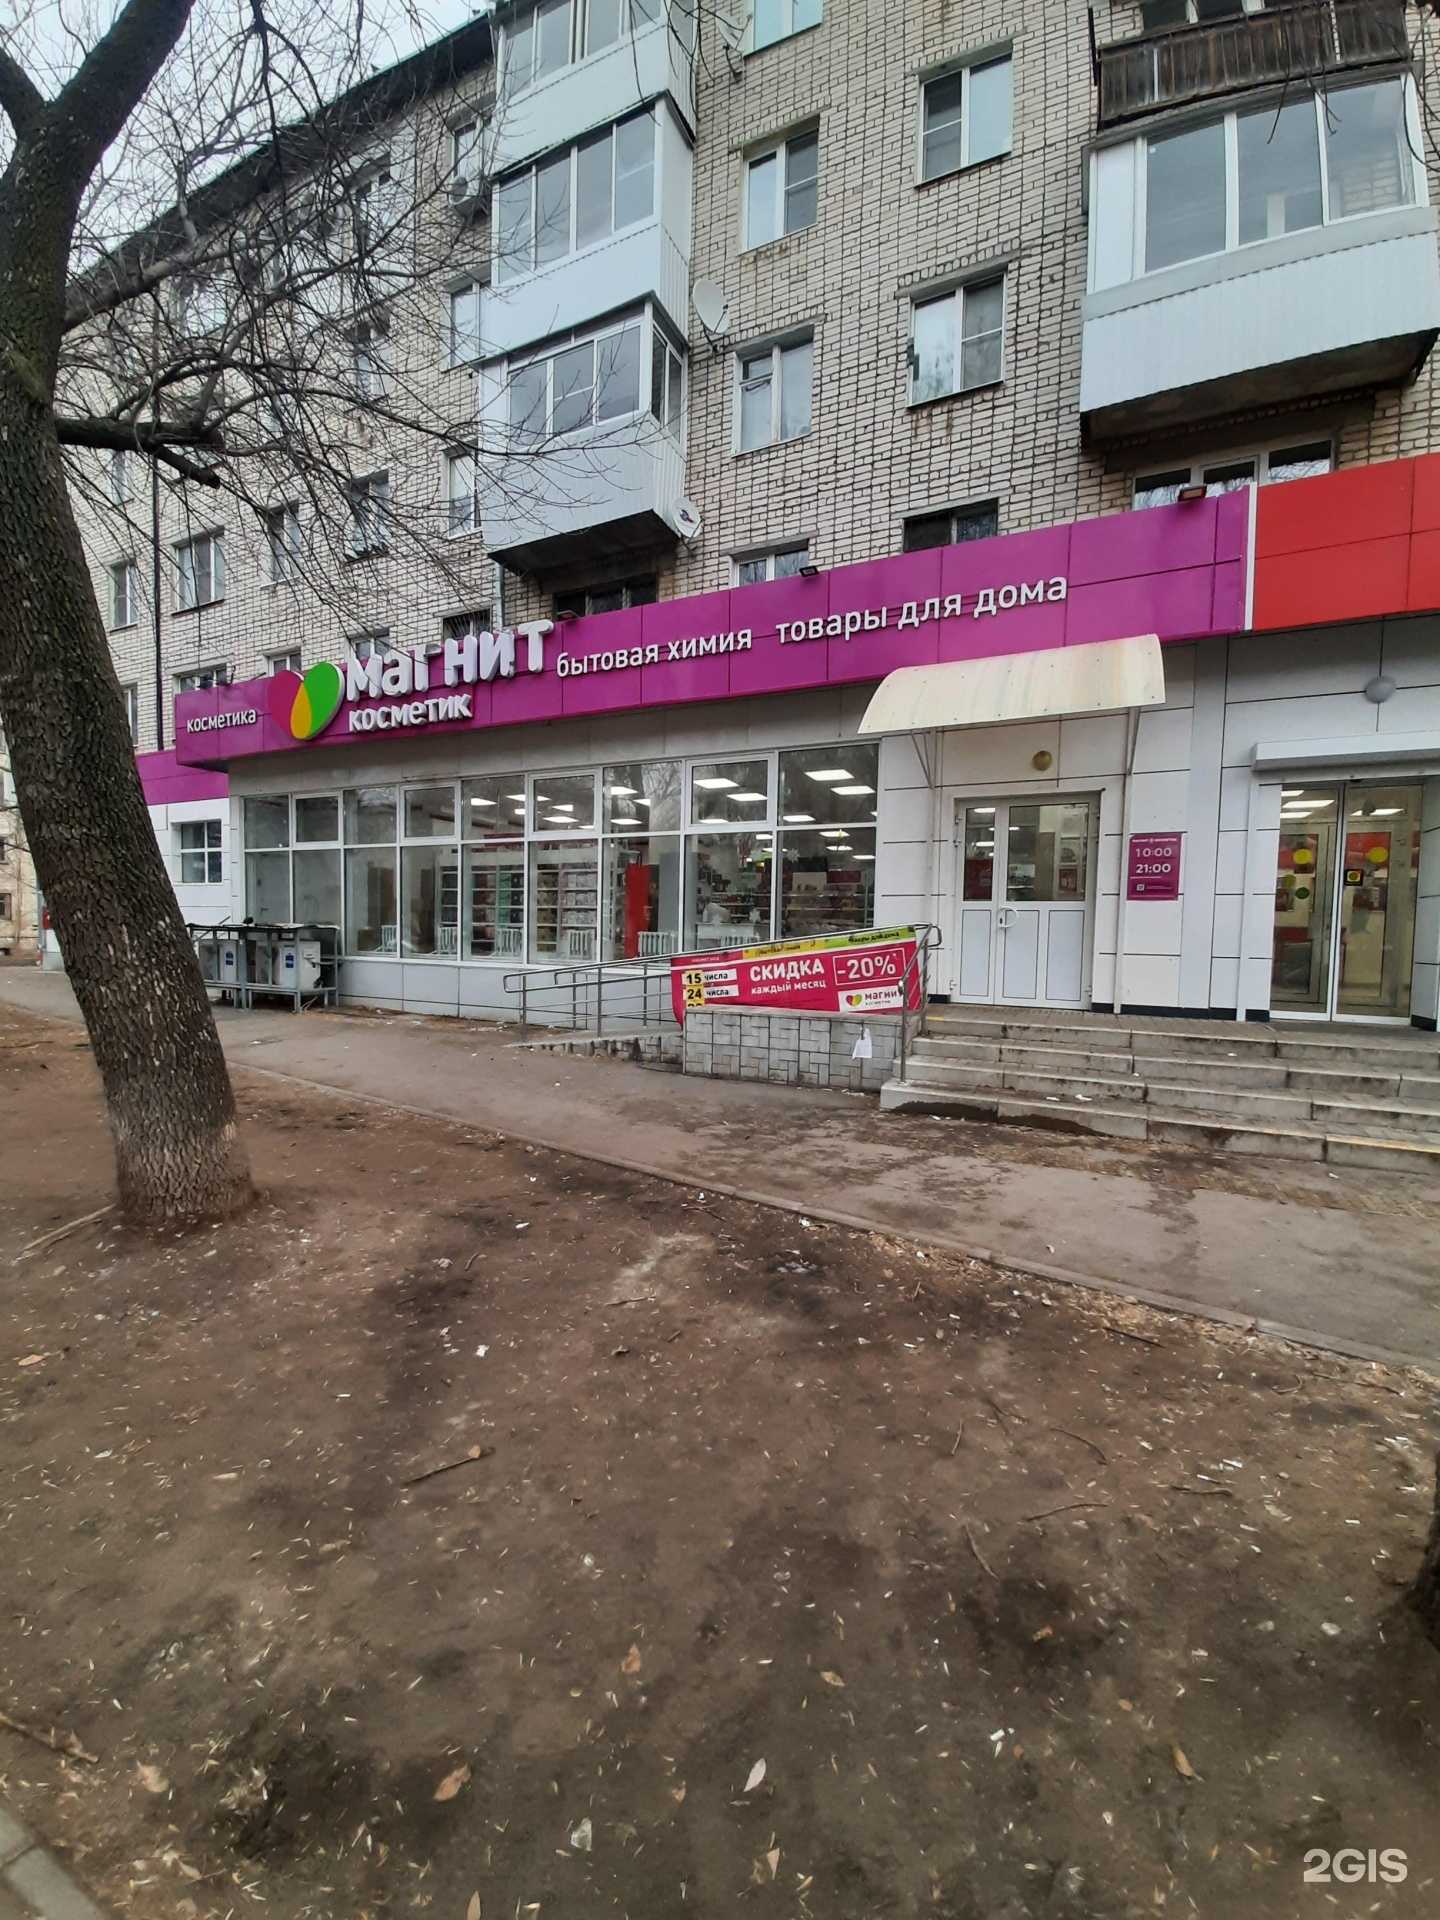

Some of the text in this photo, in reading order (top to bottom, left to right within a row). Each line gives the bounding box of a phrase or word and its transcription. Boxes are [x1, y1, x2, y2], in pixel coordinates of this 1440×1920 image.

[775, 575, 1068, 643] товары для дома
[556, 626, 753, 678] бытовая химия
[187, 708, 257, 733] косметика
[349, 693, 472, 733] косметик
[1136, 847, 1172, 857] 10:00
[1135, 863, 1171, 873] 21:00
[686, 973, 728, 985] 15 числа
[750, 958, 825, 982] СКИДКА
[687, 988, 702, 1000] 24
[751, 980, 827, 995] каждый месяц
